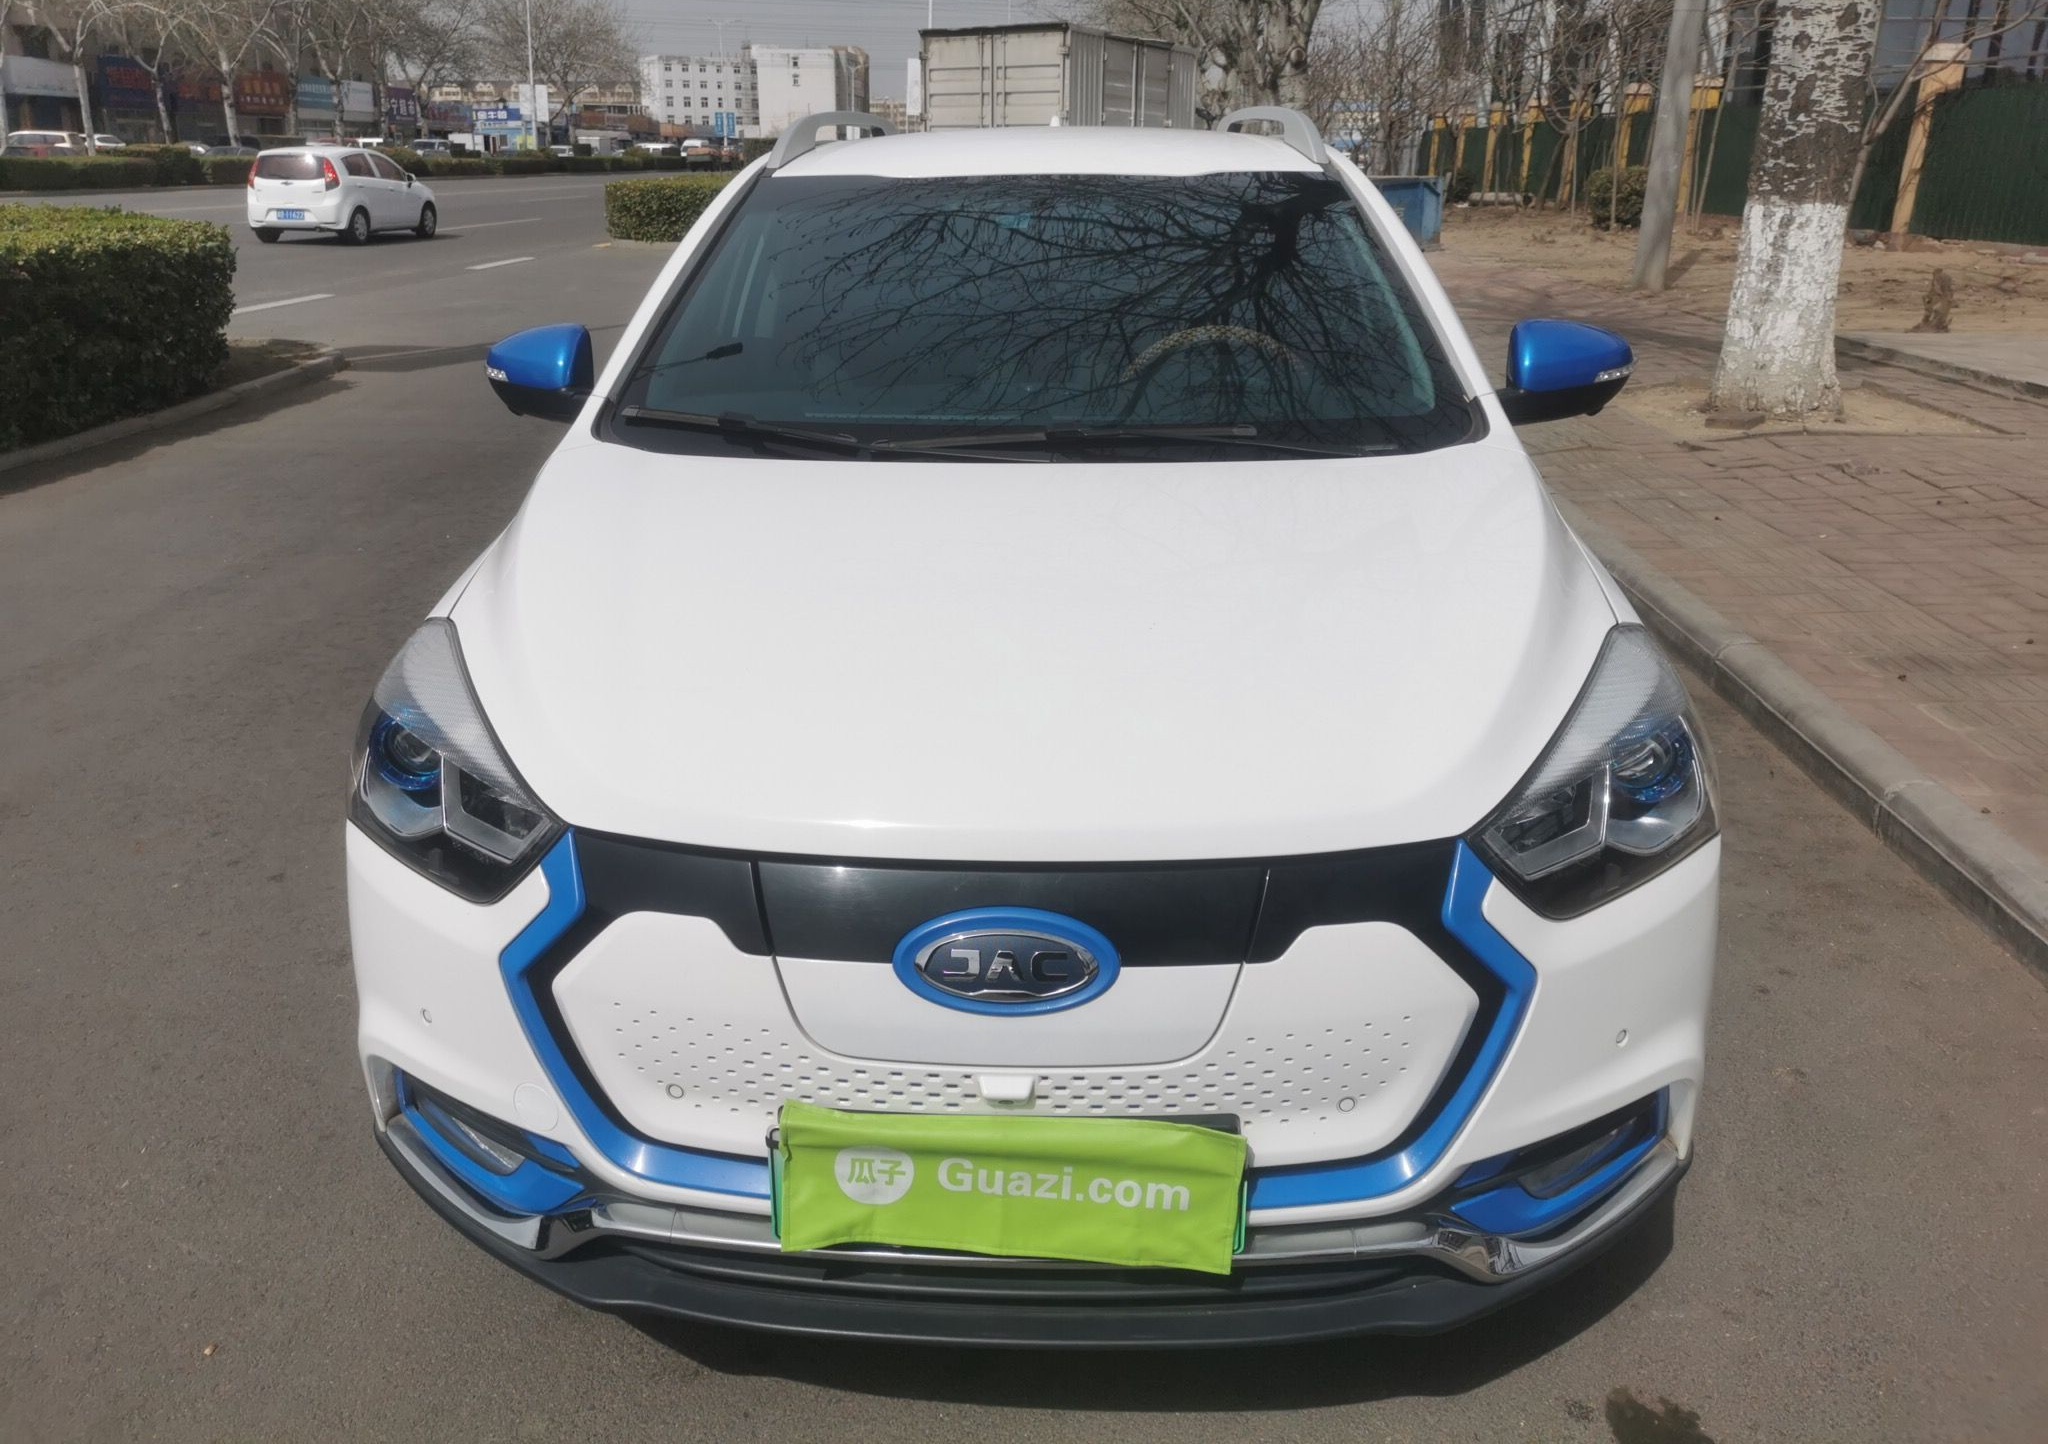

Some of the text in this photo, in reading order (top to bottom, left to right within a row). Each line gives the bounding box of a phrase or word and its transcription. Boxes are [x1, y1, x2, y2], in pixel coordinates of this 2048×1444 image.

[942, 948, 1069, 983] JAC
[847, 1157, 1191, 1211] 瓜子 Guazi.com
